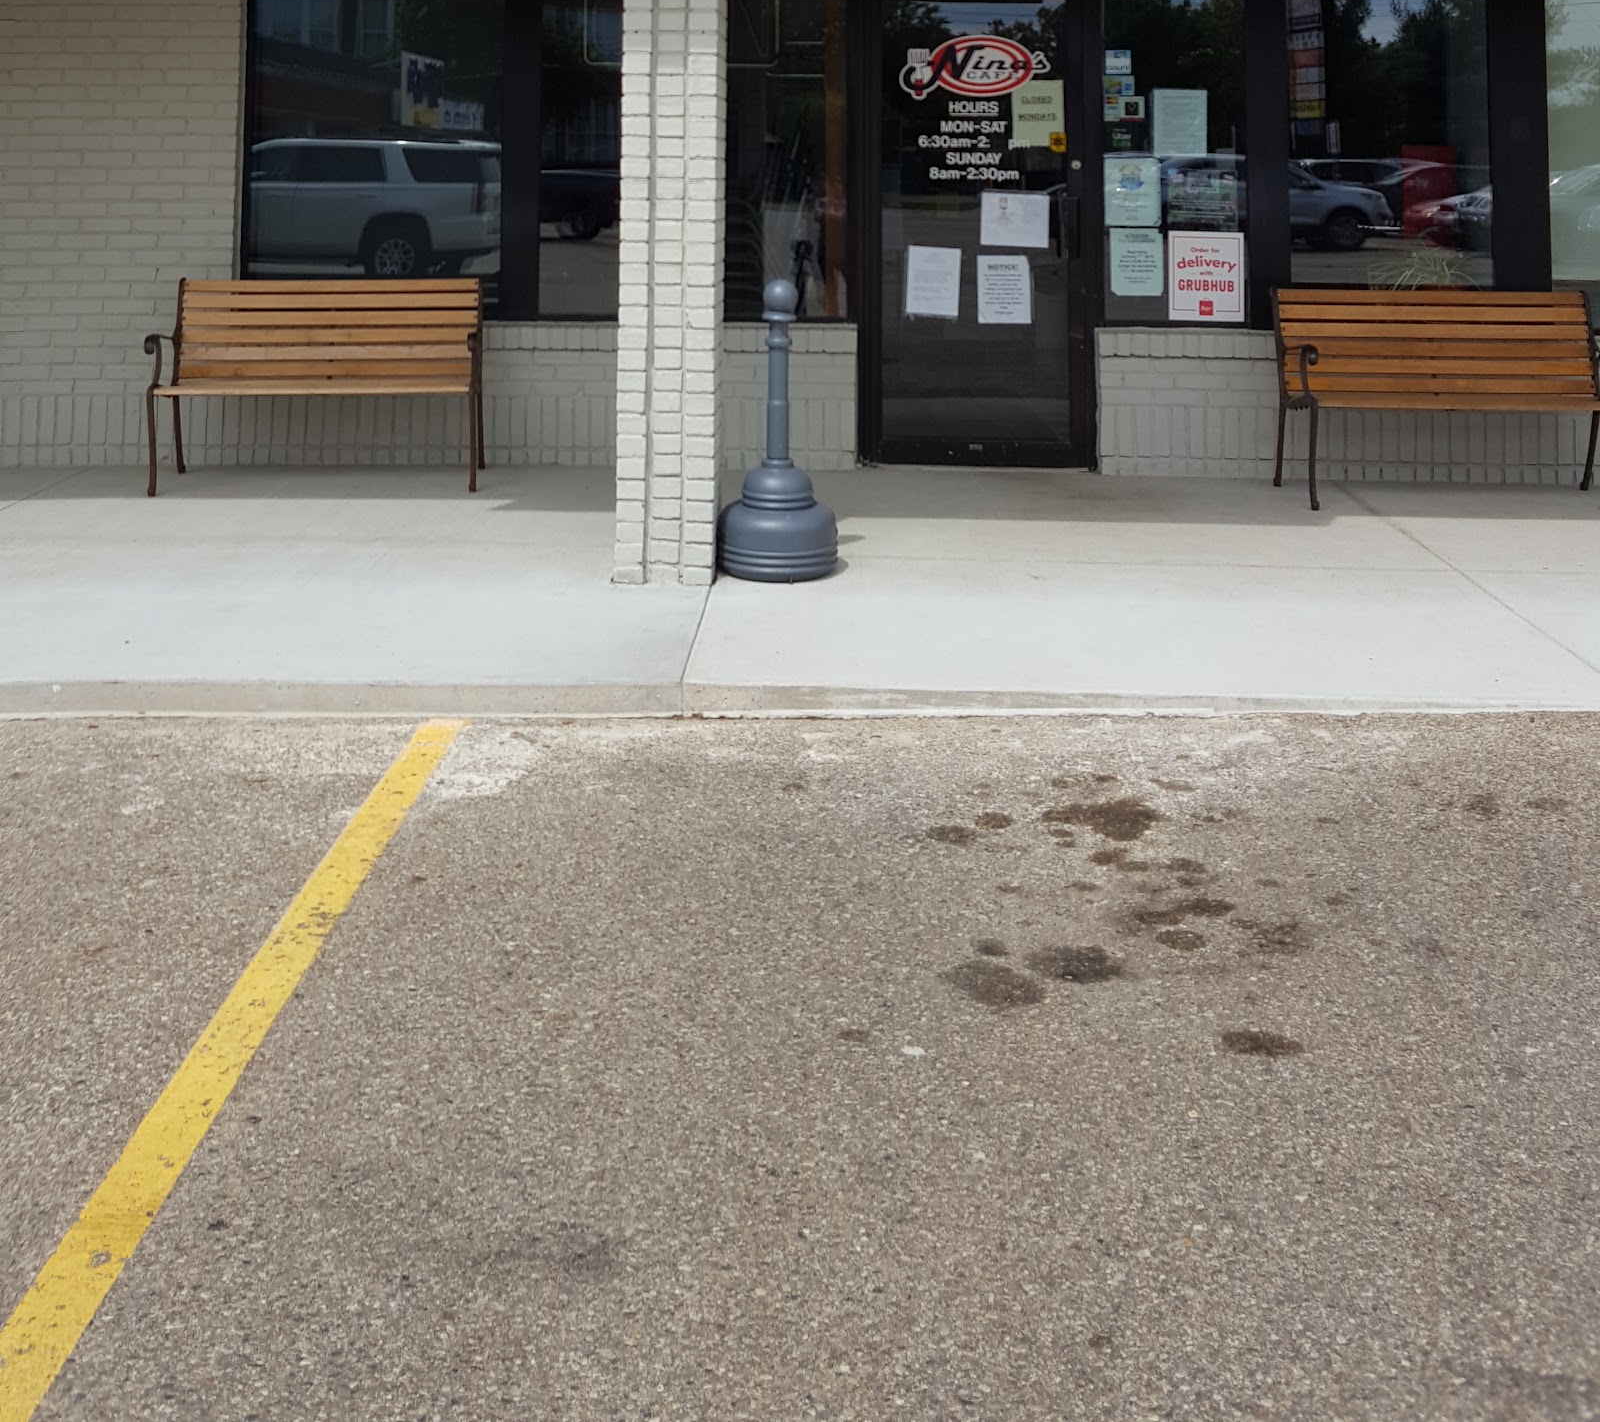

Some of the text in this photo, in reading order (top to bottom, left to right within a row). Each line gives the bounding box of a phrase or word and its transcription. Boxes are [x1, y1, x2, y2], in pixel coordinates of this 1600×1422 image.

[903, 45, 1049, 91] Nina's
[966, 70, 1021, 79] CAFE
[949, 101, 999, 114] HOURS
[940, 121, 1008, 134] MON-SAT
[945, 152, 1002, 165] SUNDAY
[929, 167, 1019, 182] 8am-2:30pm
[1177, 255, 1237, 273] delivery
[1178, 279, 1235, 292] GRUBHUB
